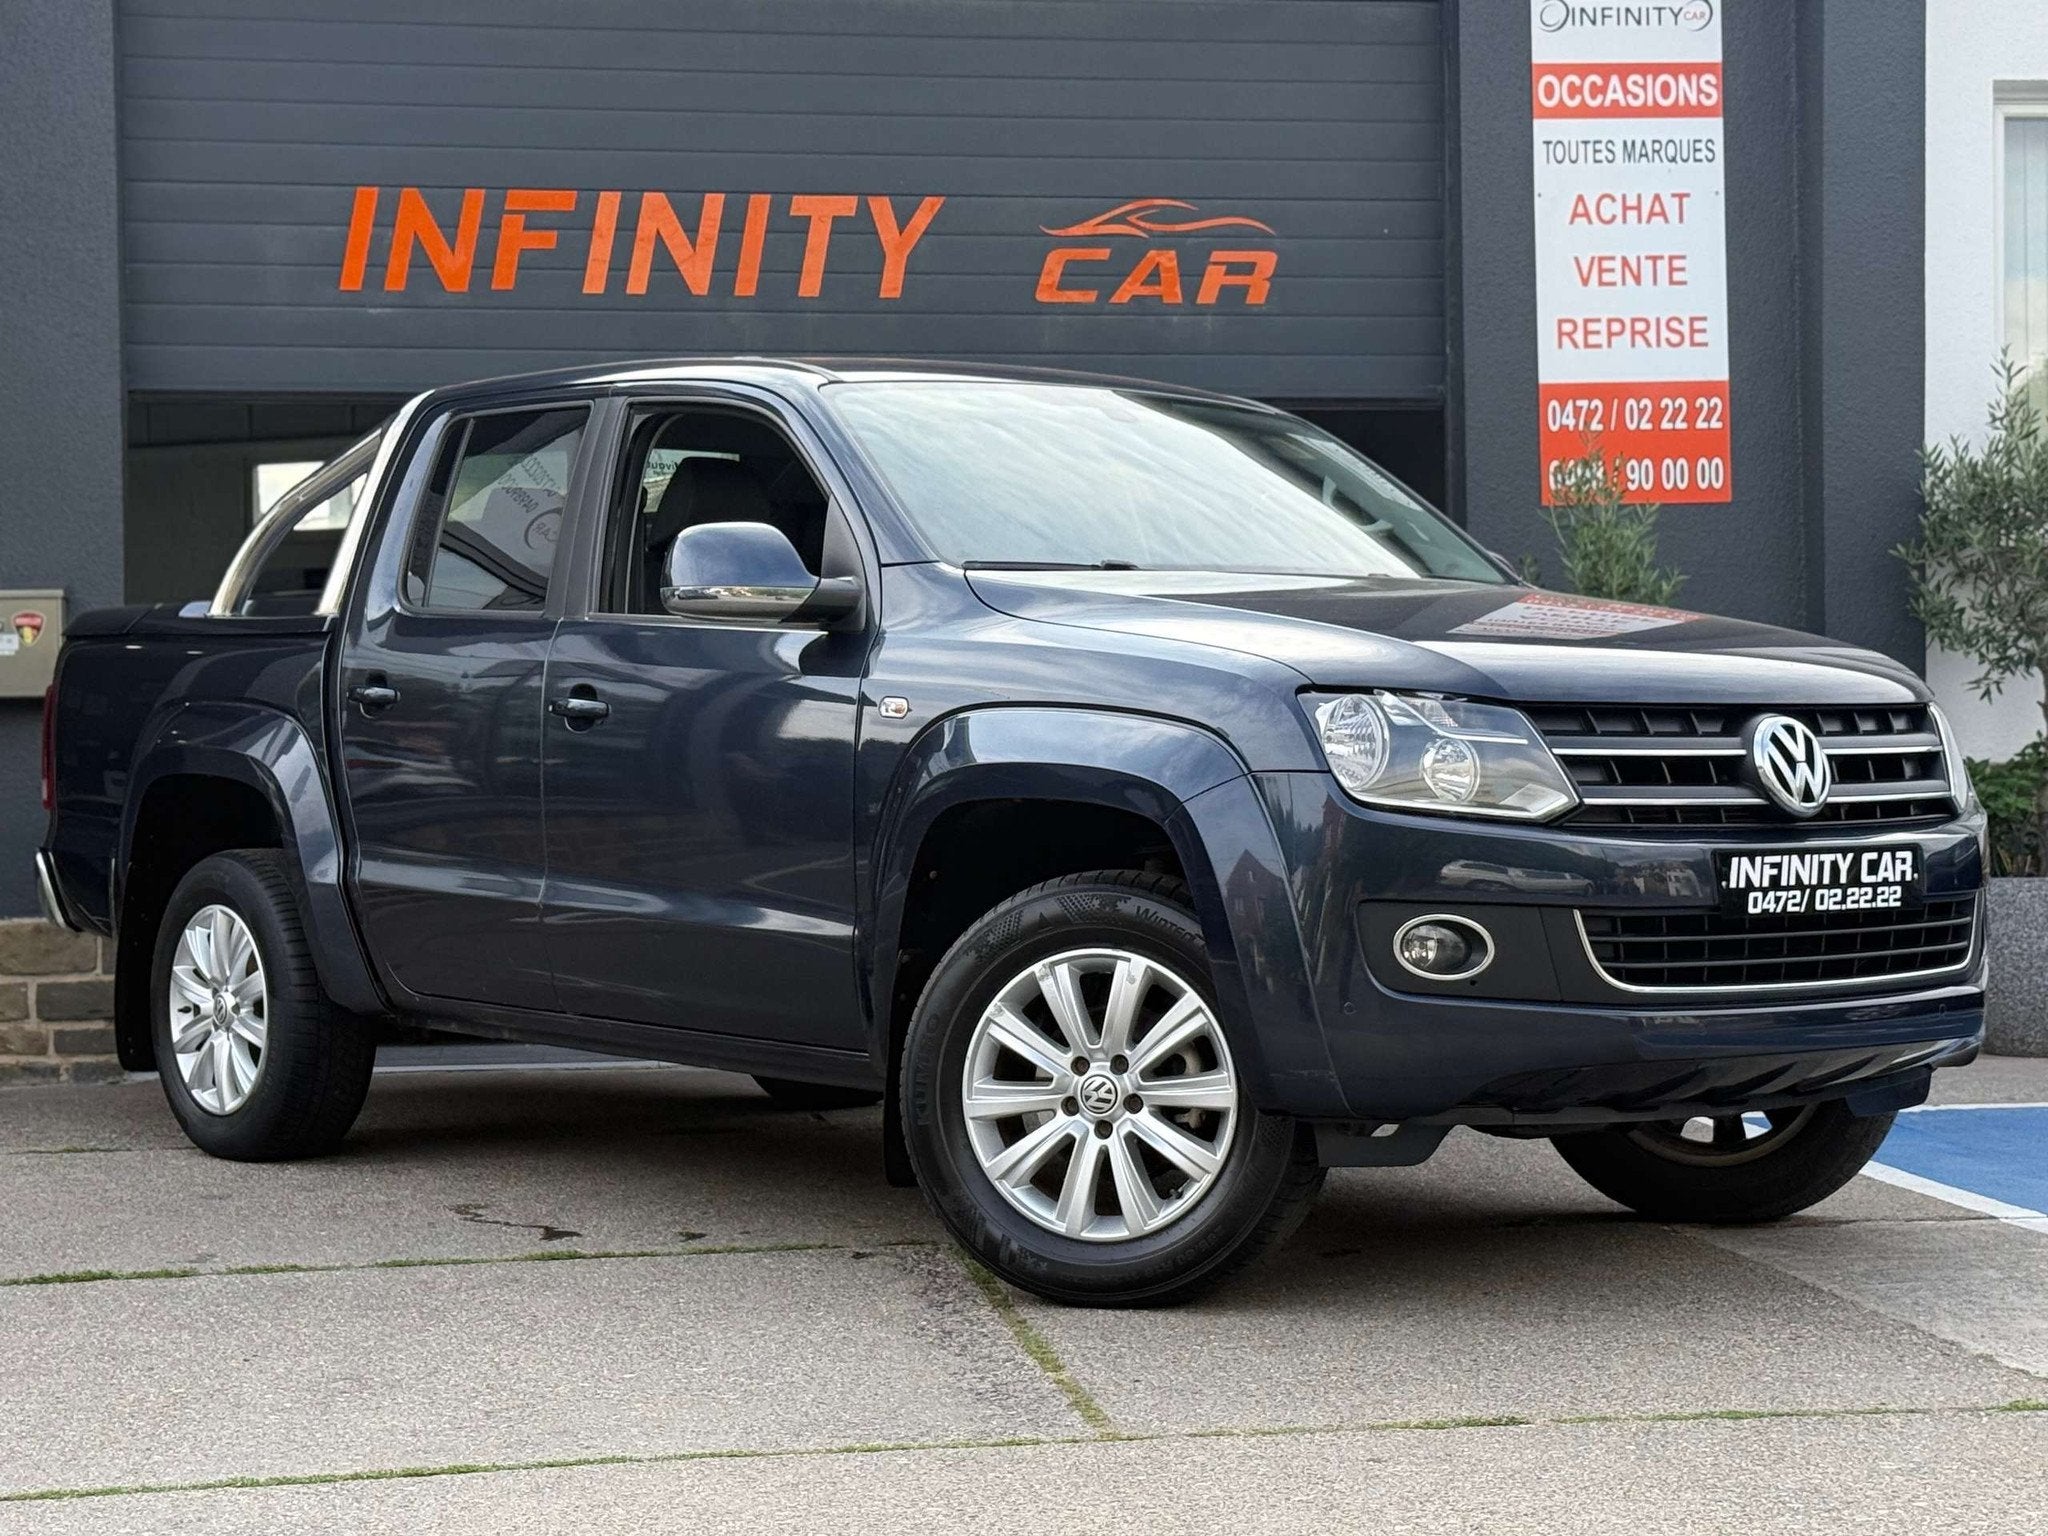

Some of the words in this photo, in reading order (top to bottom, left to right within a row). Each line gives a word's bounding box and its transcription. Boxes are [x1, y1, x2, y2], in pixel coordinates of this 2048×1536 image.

[1571, 6, 1683, 26] INFINITY
[1684, 11, 1706, 21] CAR
[1537, 73, 1718, 108] OCCASIONS
[1543, 140, 1616, 164] TOUTES
[1622, 139, 1716, 164] MARQUES
[1569, 192, 1691, 225] ACHAT
[338, 185, 945, 300] INFINITY
[1034, 248, 1278, 306] CAR
[1573, 254, 1688, 287] VENTE
[1557, 316, 1709, 349] REPRISE
[1547, 399, 1604, 432] 0472
[1610, 398, 1618, 431] /
[1625, 397, 1653, 431] 02
[1660, 397, 1688, 430] 22
[1695, 397, 1723, 429] 22
[1626, 458, 1654, 491] 90
[1661, 457, 1689, 490] 00
[1696, 456, 1724, 490] 00
[1729, 852, 1854, 888] INFINITY
[1861, 850, 1913, 883] CAR
[1747, 889, 1811, 914] 0472/
[1815, 886, 1902, 911] 02.22.22
